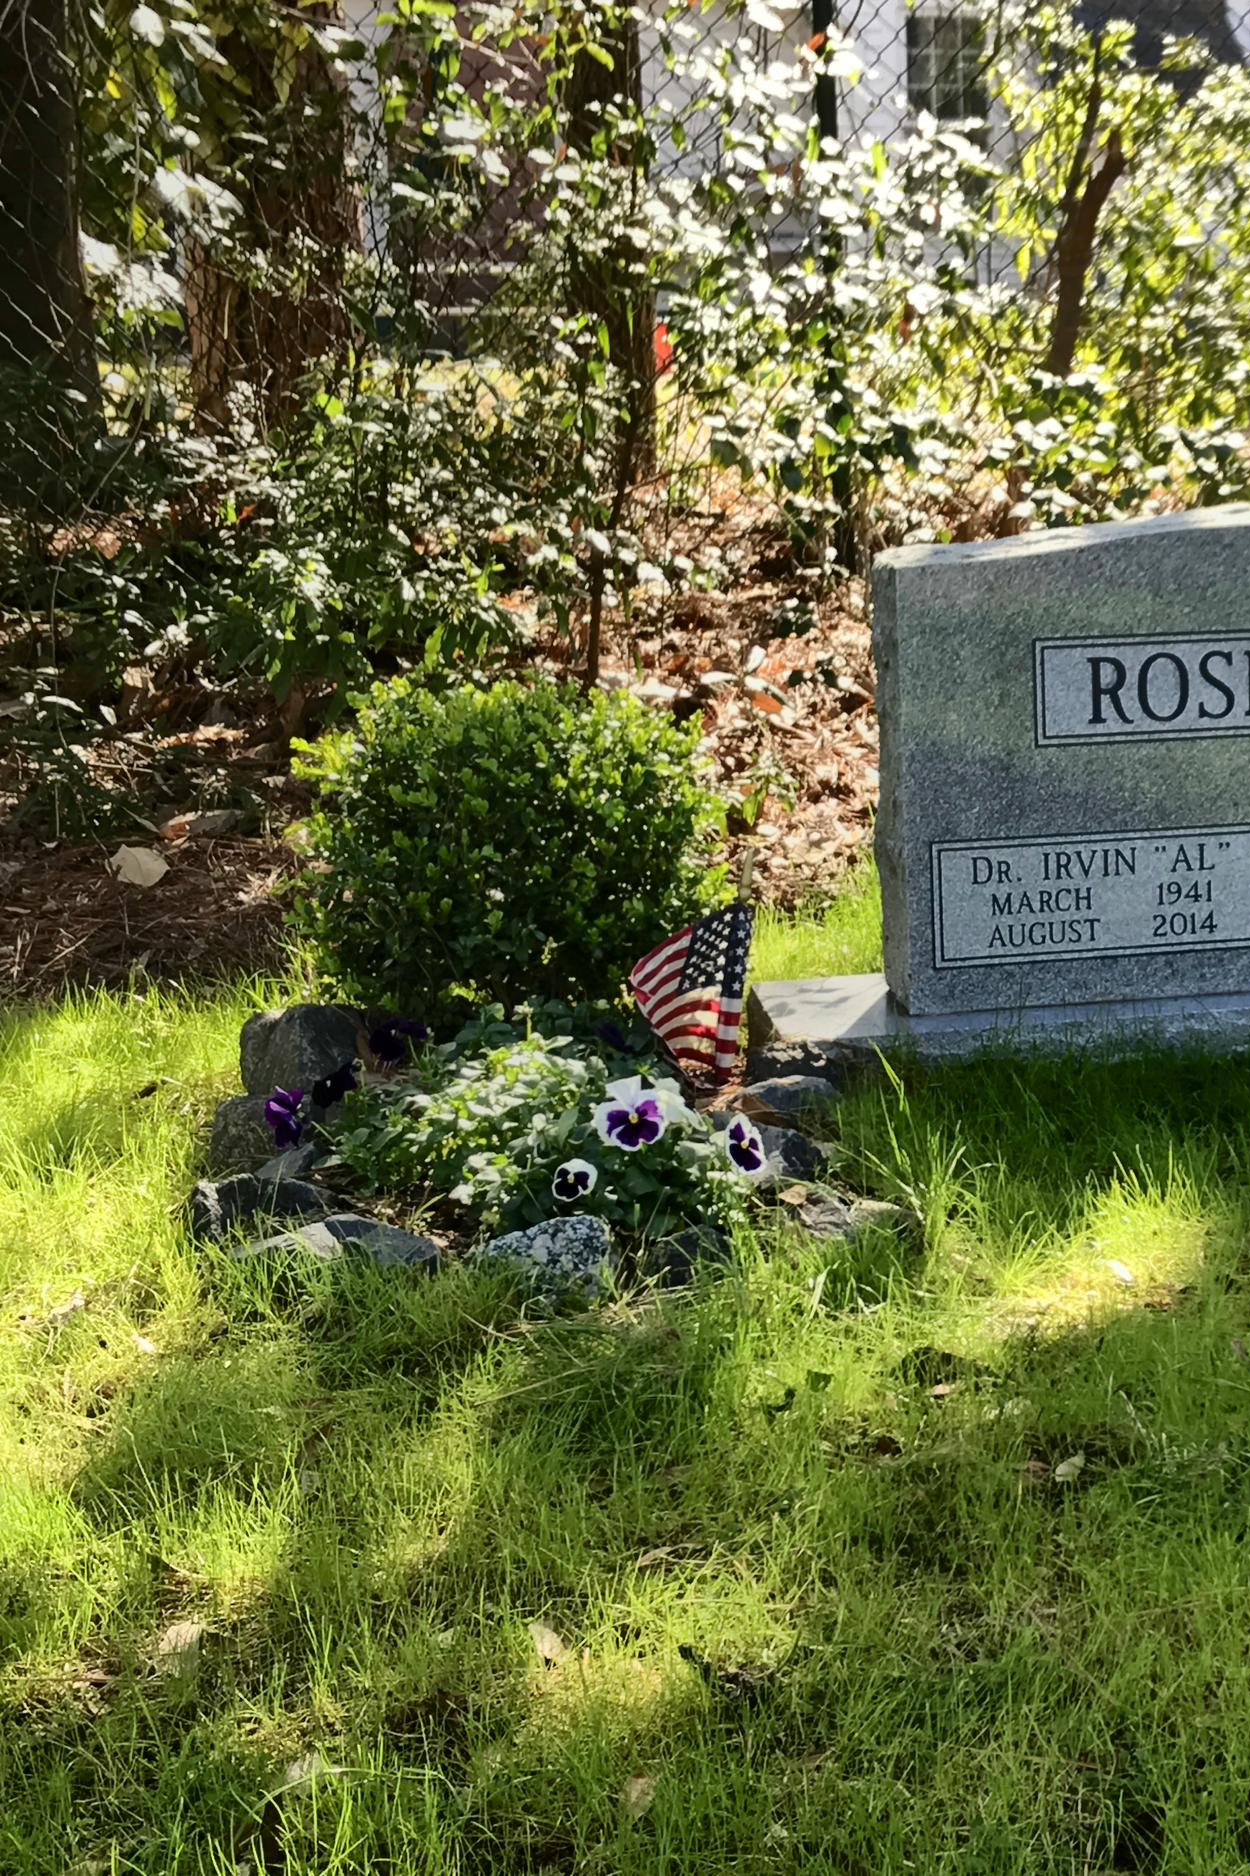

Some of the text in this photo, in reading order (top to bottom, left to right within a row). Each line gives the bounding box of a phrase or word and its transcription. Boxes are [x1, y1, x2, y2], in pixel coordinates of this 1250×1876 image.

[1042, 846, 1138, 881] IRVIN
[990, 880, 1214, 917] MARCH 1941
[988, 912, 1219, 949] AUGUST 2014
